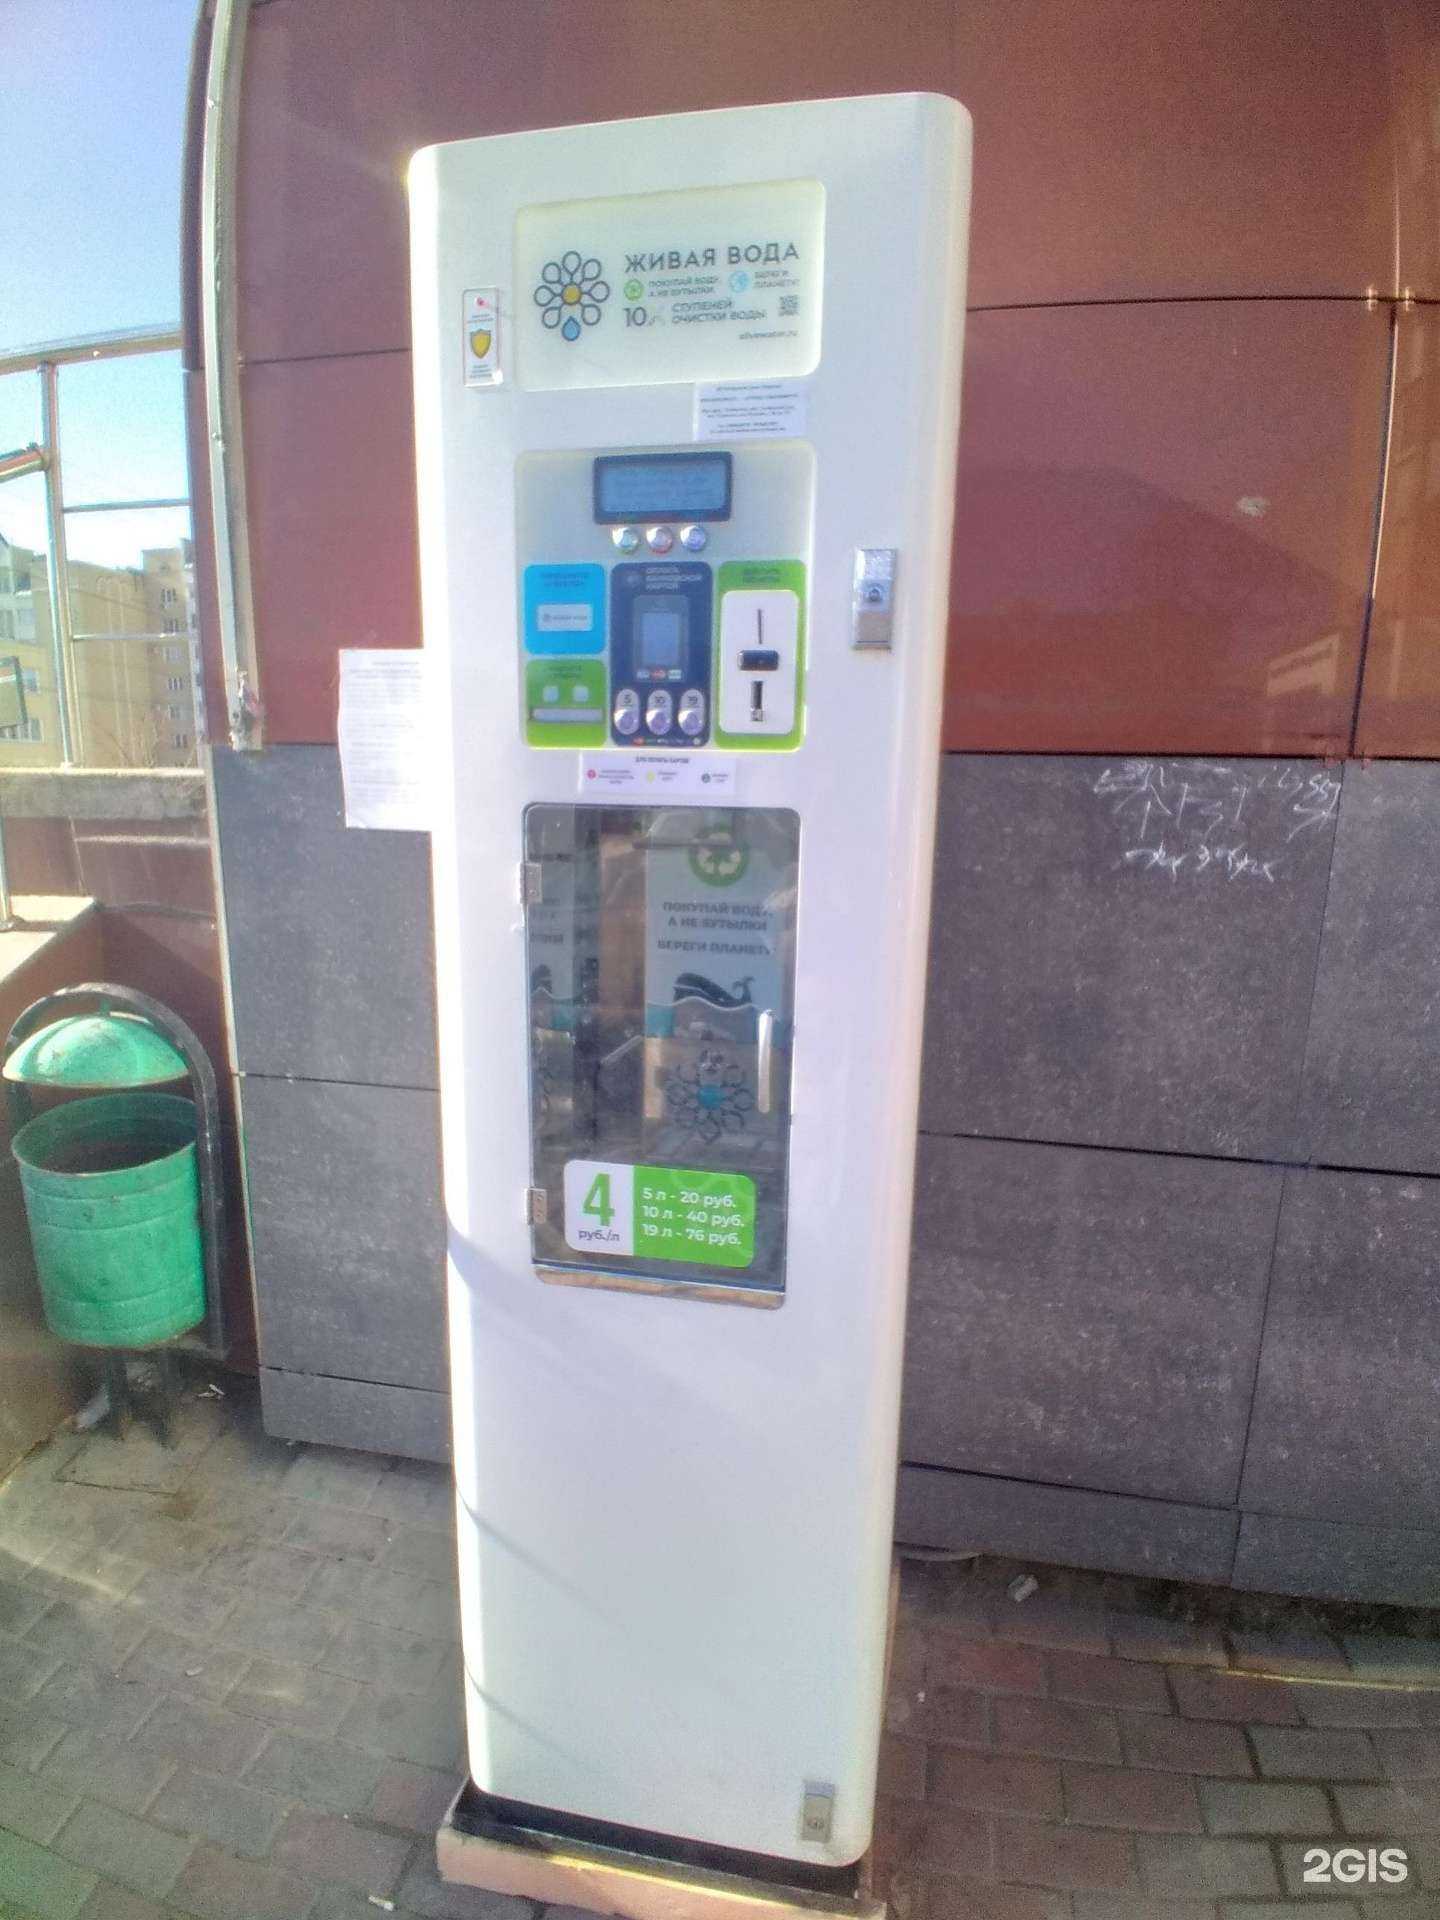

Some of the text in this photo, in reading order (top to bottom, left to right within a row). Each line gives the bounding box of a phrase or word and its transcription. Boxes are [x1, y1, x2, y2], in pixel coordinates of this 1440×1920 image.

[624, 242, 800, 273] ЖИВАЯ ВОДА
[663, 901, 729, 914] ПОКУПАЙ
[668, 915, 767, 931] А НЕ БУТЫЛКИ
[656, 939, 707, 952] БЕРЕГИ
[583, 1173, 616, 1227] 4
[642, 1187, 653, 1200] 5
[680, 1191, 700, 1204] 20
[703, 1194, 736, 1209] руб.
[642, 1205, 659, 1218] 10
[662, 1209, 673, 1220] л
[686, 1210, 708, 1223] 40
[711, 1214, 745, 1228] руб.
[578, 1229, 620, 1242] руб./л
[642, 1223, 659, 1236] 19
[662, 1227, 673, 1238] л
[685, 1228, 705, 1241] 76
[708, 1232, 742, 1246] руб.
